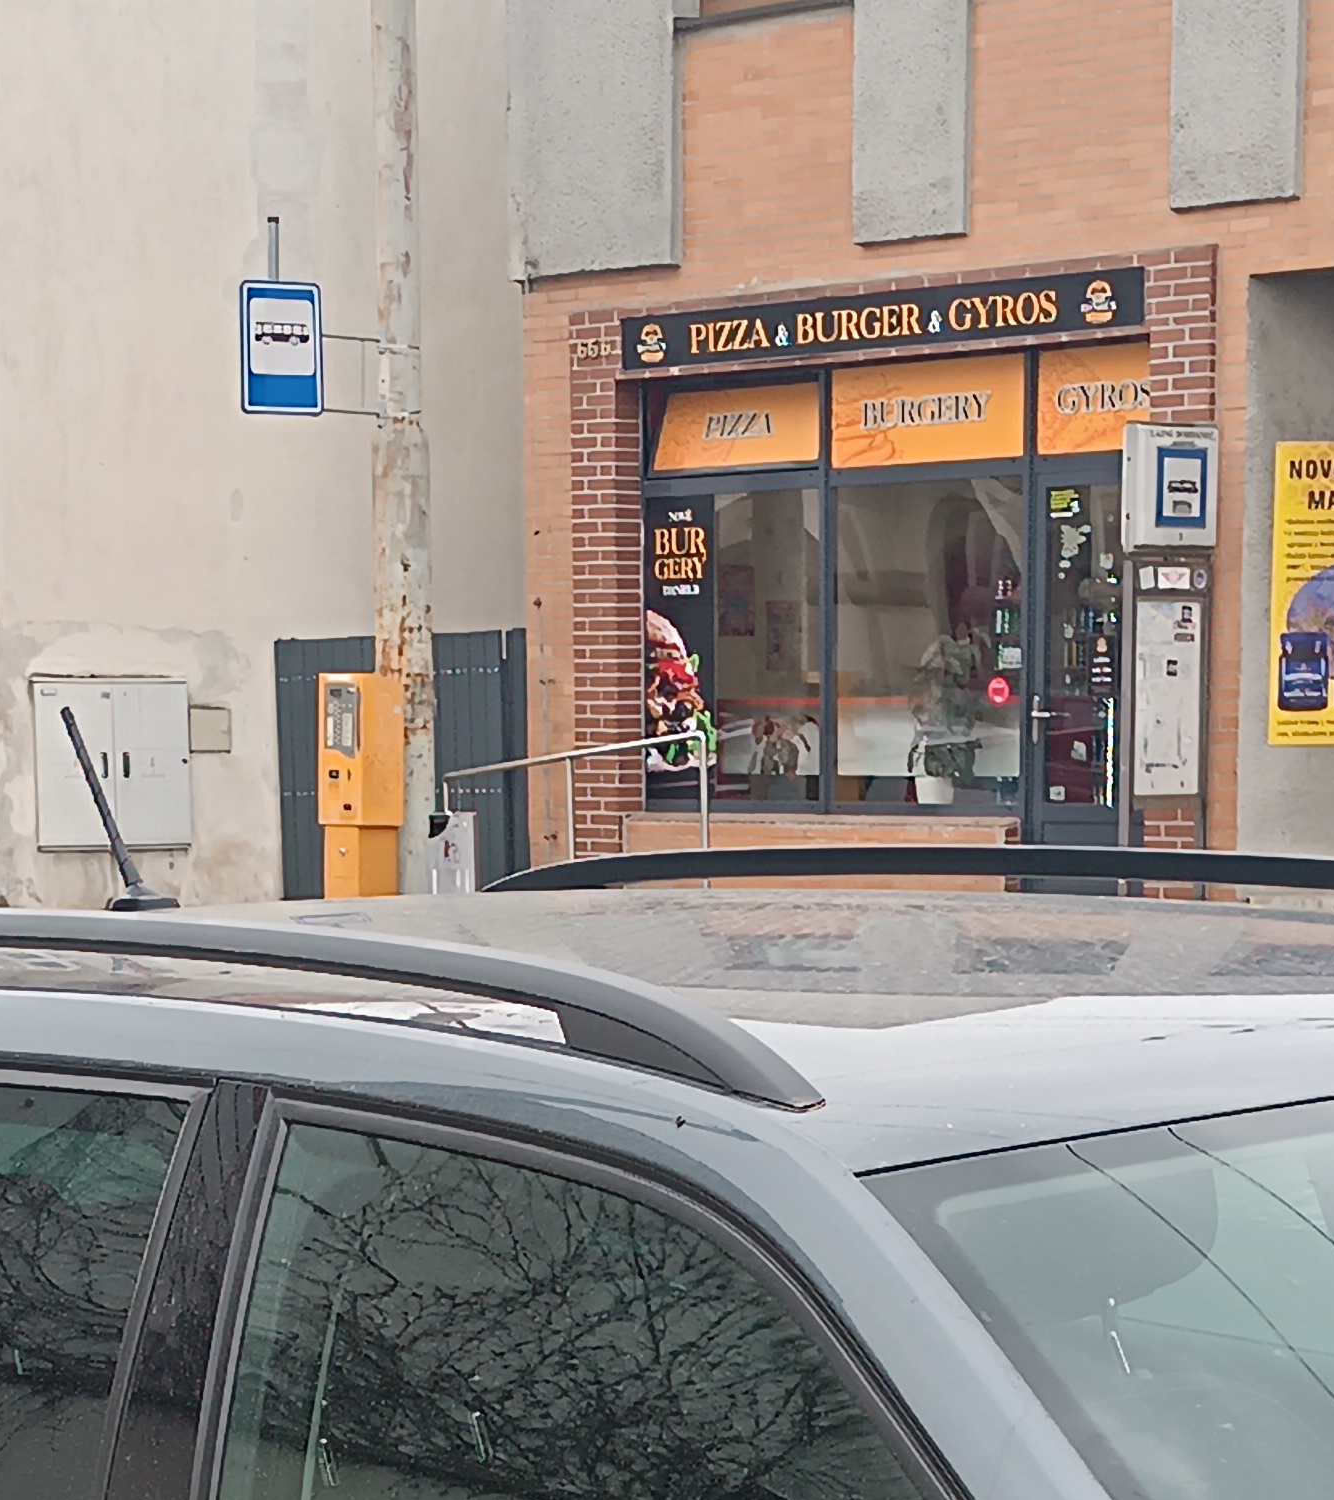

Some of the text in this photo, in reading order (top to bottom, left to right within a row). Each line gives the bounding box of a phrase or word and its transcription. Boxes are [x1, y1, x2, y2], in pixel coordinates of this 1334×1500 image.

[690, 290, 1057, 354] PIZZA & BURGER & GYROS
[862, 391, 991, 430] BURGERY
[1056, 378, 1150, 415] GYROS
[703, 411, 774, 440] PIZZA
[654, 527, 707, 560] BUR
[654, 556, 703, 581] GERY
